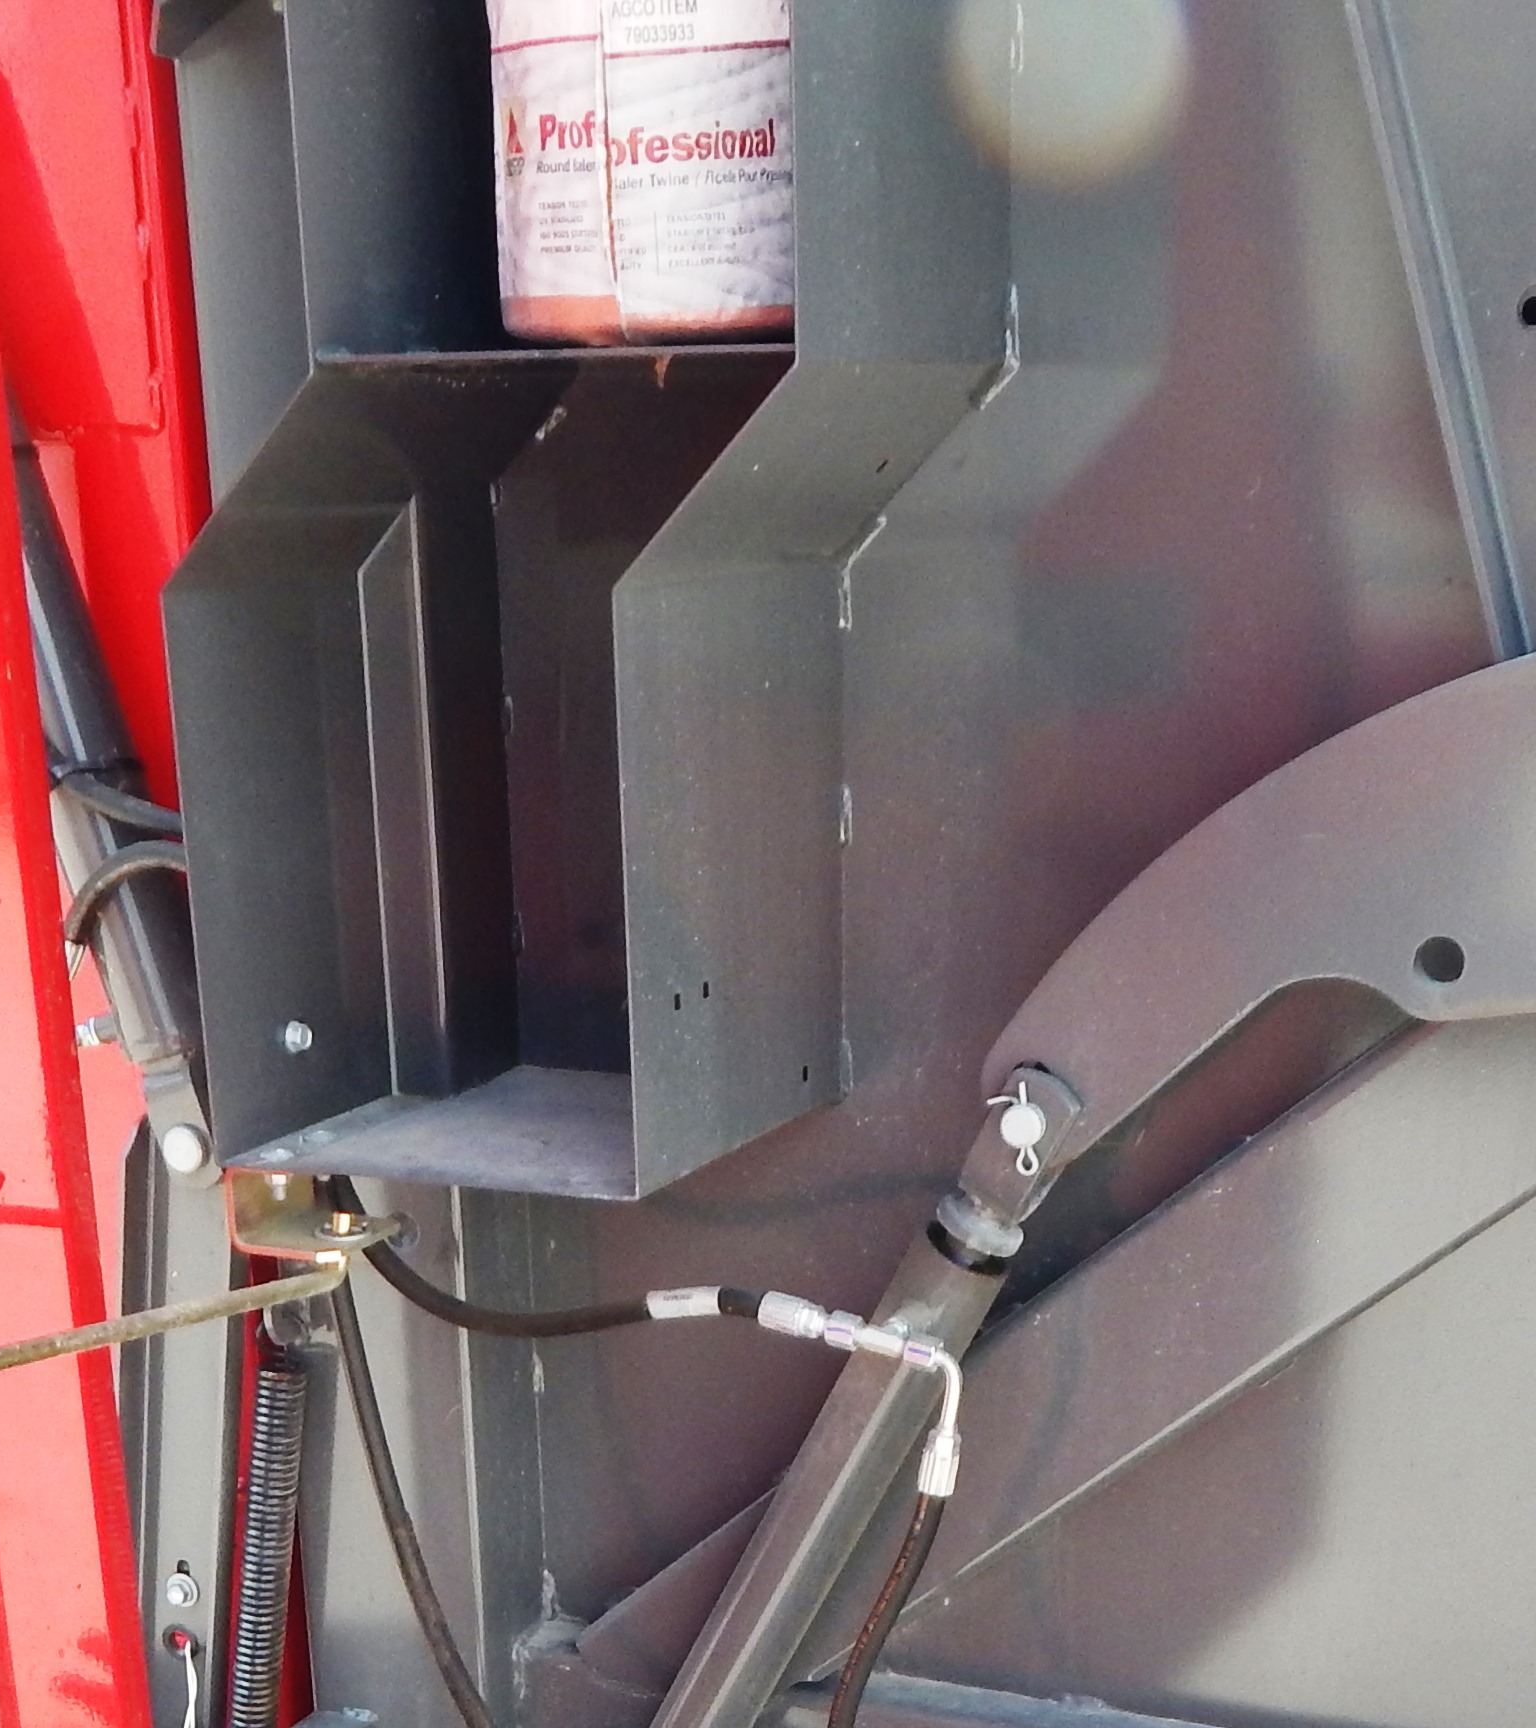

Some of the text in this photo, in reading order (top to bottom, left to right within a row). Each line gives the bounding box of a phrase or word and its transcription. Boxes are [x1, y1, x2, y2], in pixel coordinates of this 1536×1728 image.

[611, 0, 698, 18] AGCO ITEM
[536, 159, 570, 174] Round
[650, 173, 690, 187] Twine
